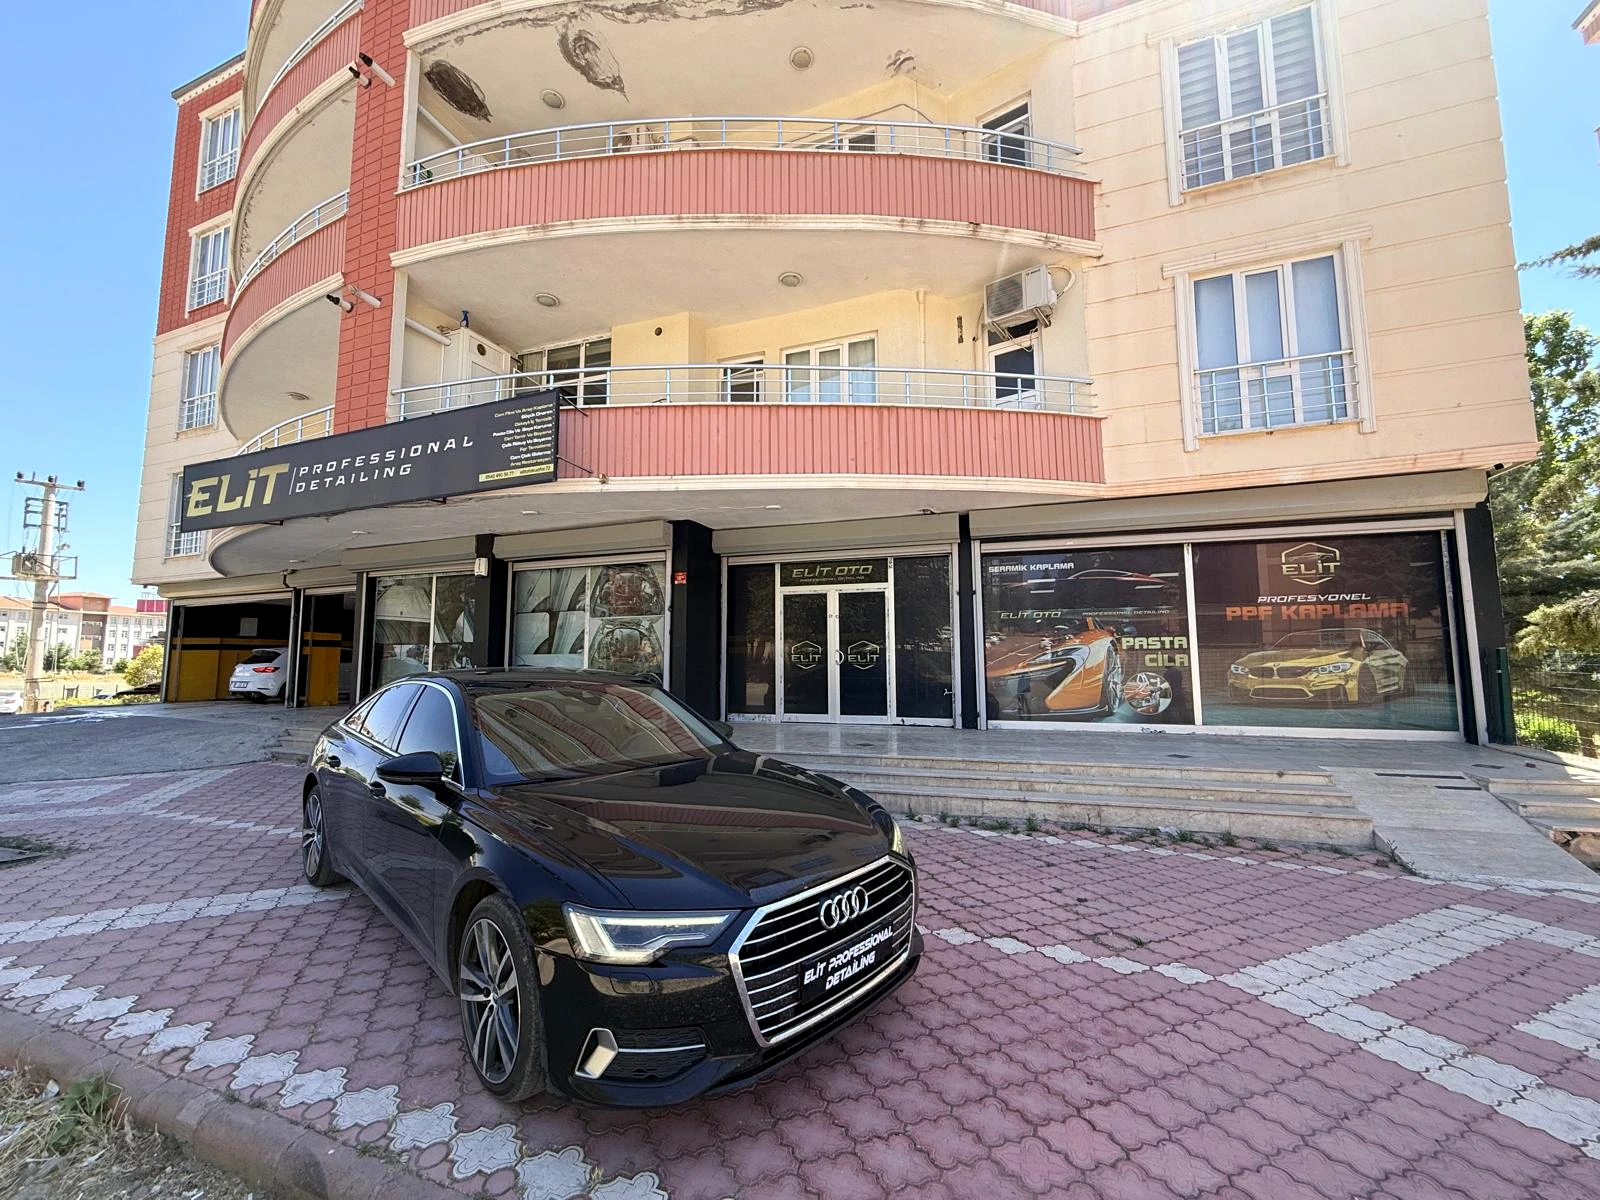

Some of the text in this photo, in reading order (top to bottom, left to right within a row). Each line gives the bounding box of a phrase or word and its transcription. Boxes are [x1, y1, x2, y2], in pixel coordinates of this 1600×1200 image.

[299, 436, 473, 477] PROFESSIONAL
[295, 463, 412, 493] DETAILING
[835, 565, 873, 576] OTO
[1029, 562, 1075, 571] KAPLAMA
[1257, 593, 1371, 604] PROFESYONEL
[1033, 611, 1062, 619] OTO
[1225, 602, 1409, 621] PPF KAPLAMA
[1121, 636, 1188, 650] PASTA
[1145, 651, 1189, 667] CİLA
